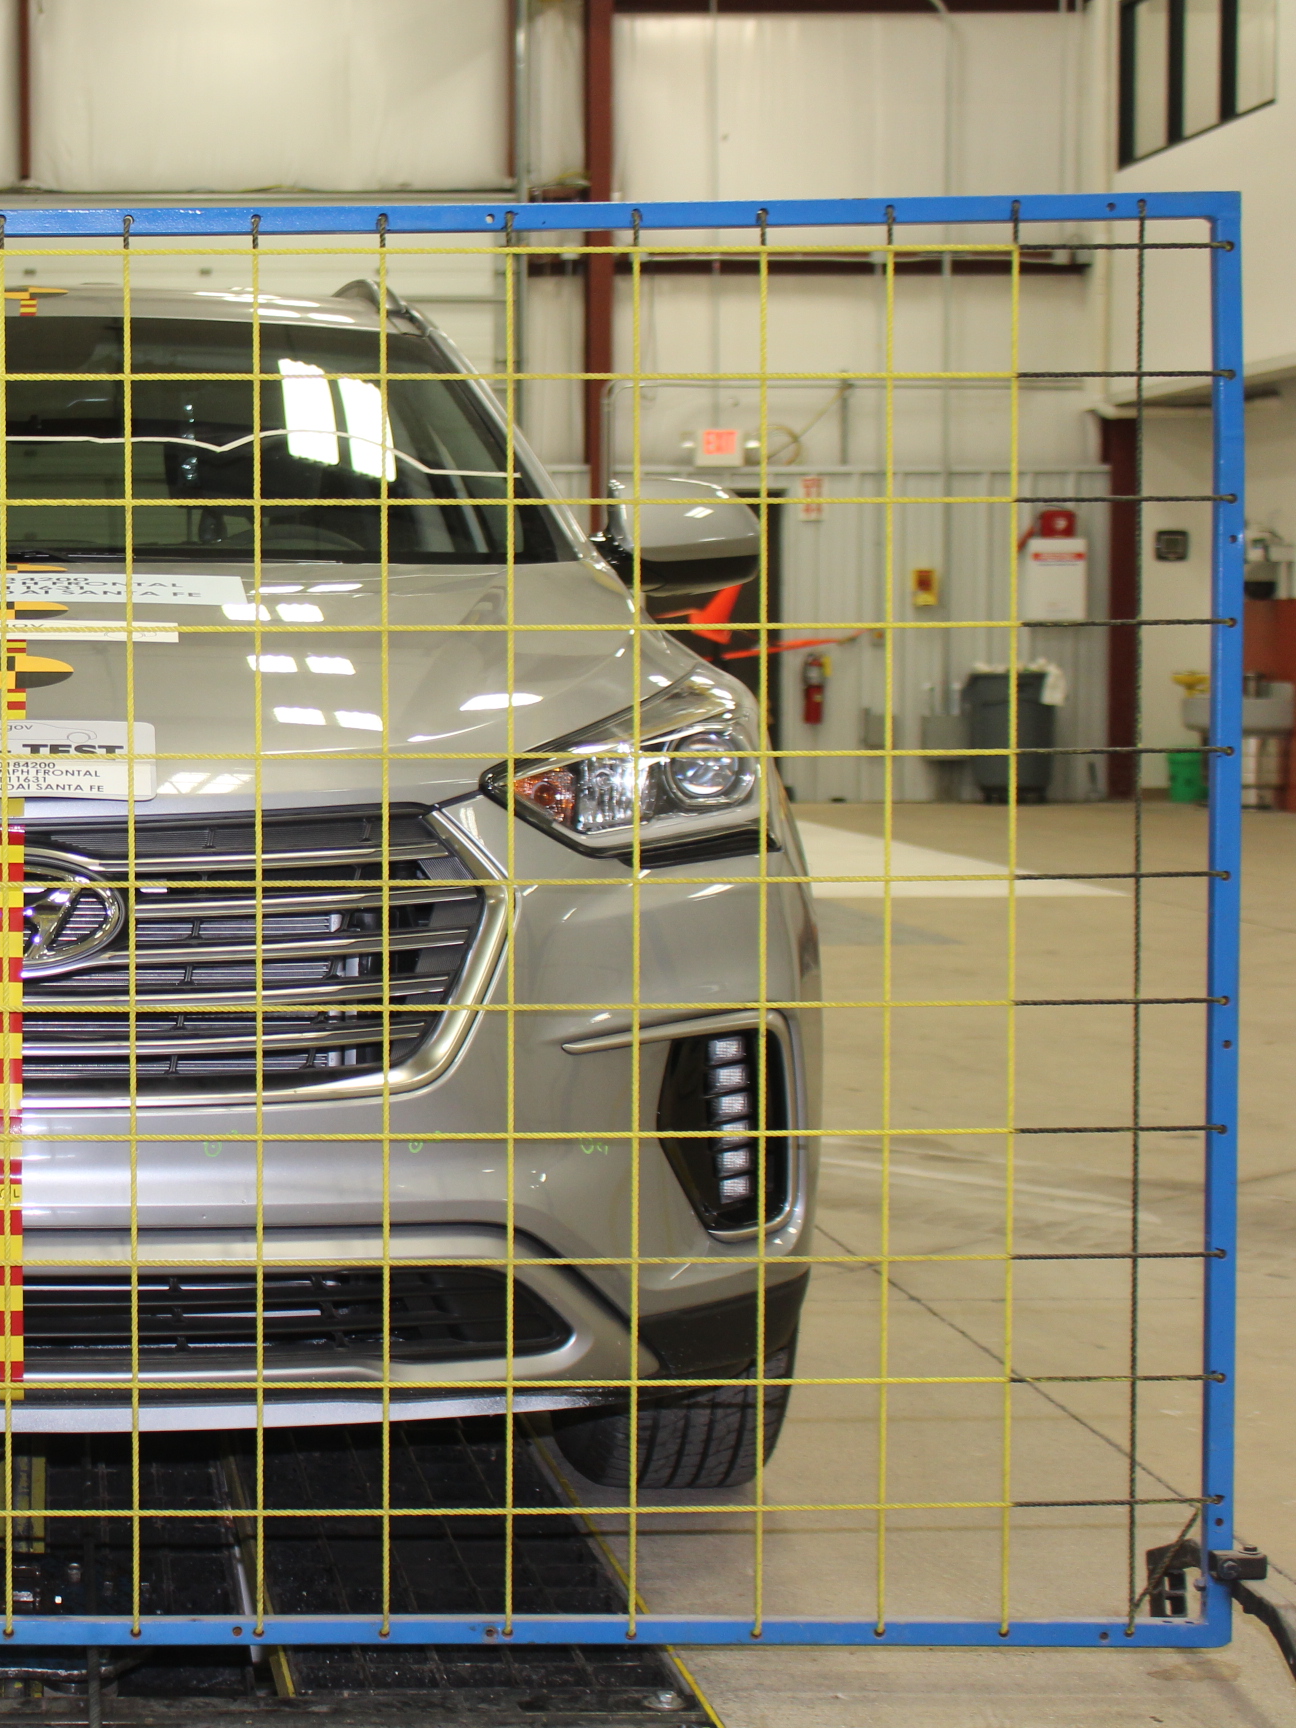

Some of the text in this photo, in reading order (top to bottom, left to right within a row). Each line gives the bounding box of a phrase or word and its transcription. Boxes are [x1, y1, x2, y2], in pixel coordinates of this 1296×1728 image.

[22, 743, 124, 761] TEST
[35, 769, 101, 778] FRONTAL
[35, 783, 84, 792] SANTA
[89, 784, 104, 793] FE
